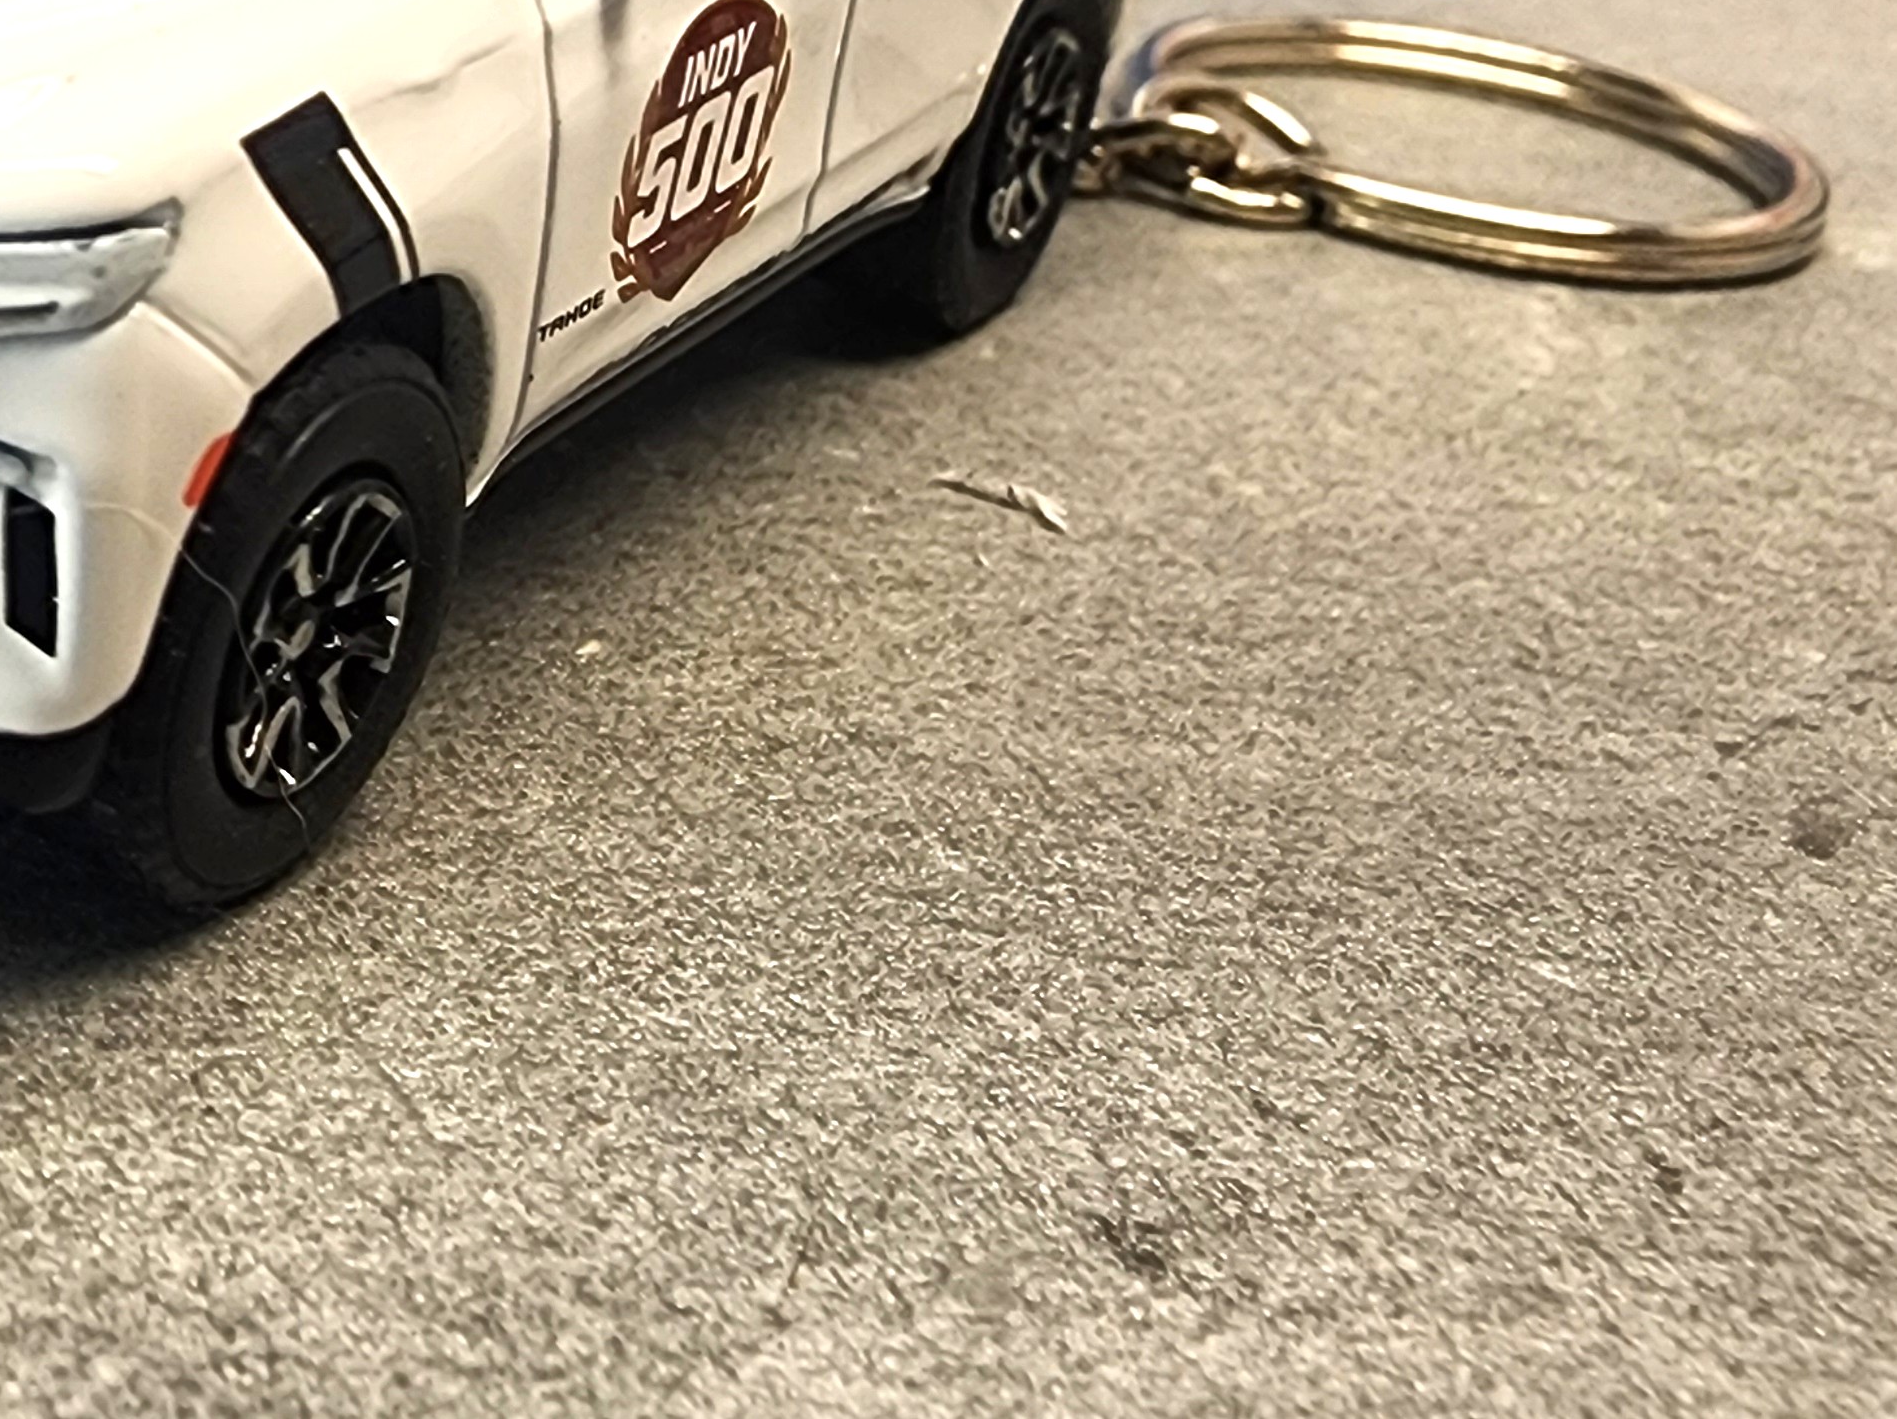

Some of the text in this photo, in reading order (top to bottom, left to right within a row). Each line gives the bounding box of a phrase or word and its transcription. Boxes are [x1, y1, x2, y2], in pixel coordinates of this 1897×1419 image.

[677, 21, 757, 109] INDY
[626, 65, 775, 249] 500
[537, 288, 607, 343] TAHOE
